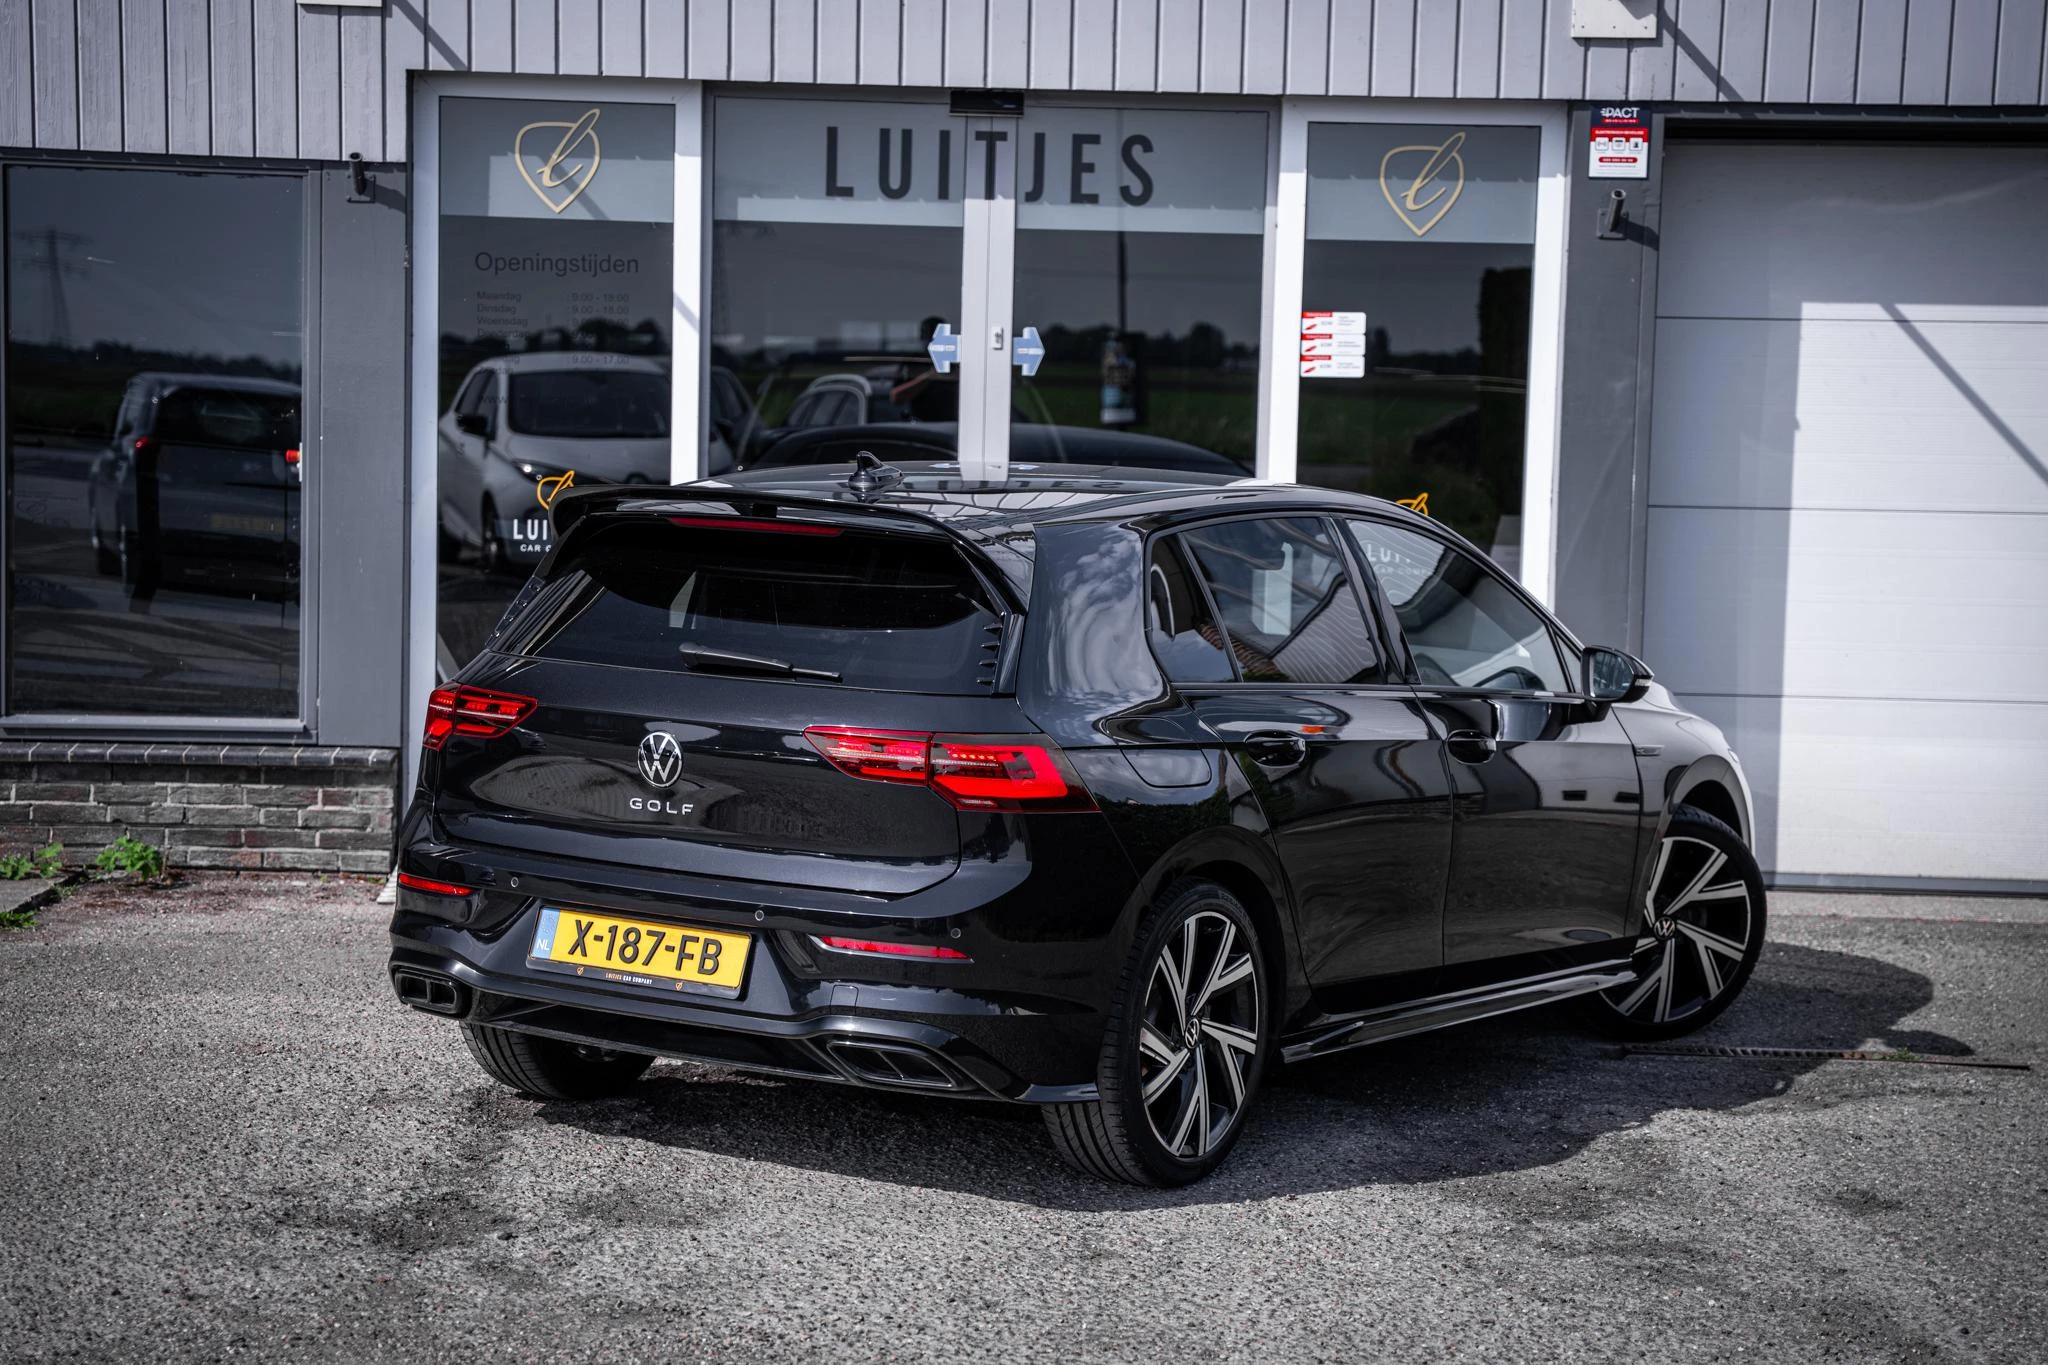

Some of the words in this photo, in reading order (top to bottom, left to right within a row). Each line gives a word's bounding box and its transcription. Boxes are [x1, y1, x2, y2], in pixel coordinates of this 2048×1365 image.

[826, 126, 1154, 206] LUITJES
[475, 252, 639, 277] Openingstijden
[520, 544, 541, 552] CAR
[629, 797, 694, 815] GOLF
[536, 938, 550, 951] NL
[568, 919, 722, 976] X-187-FB
[622, 974, 632, 982] CAR
[632, 976, 653, 984] COMPANY
